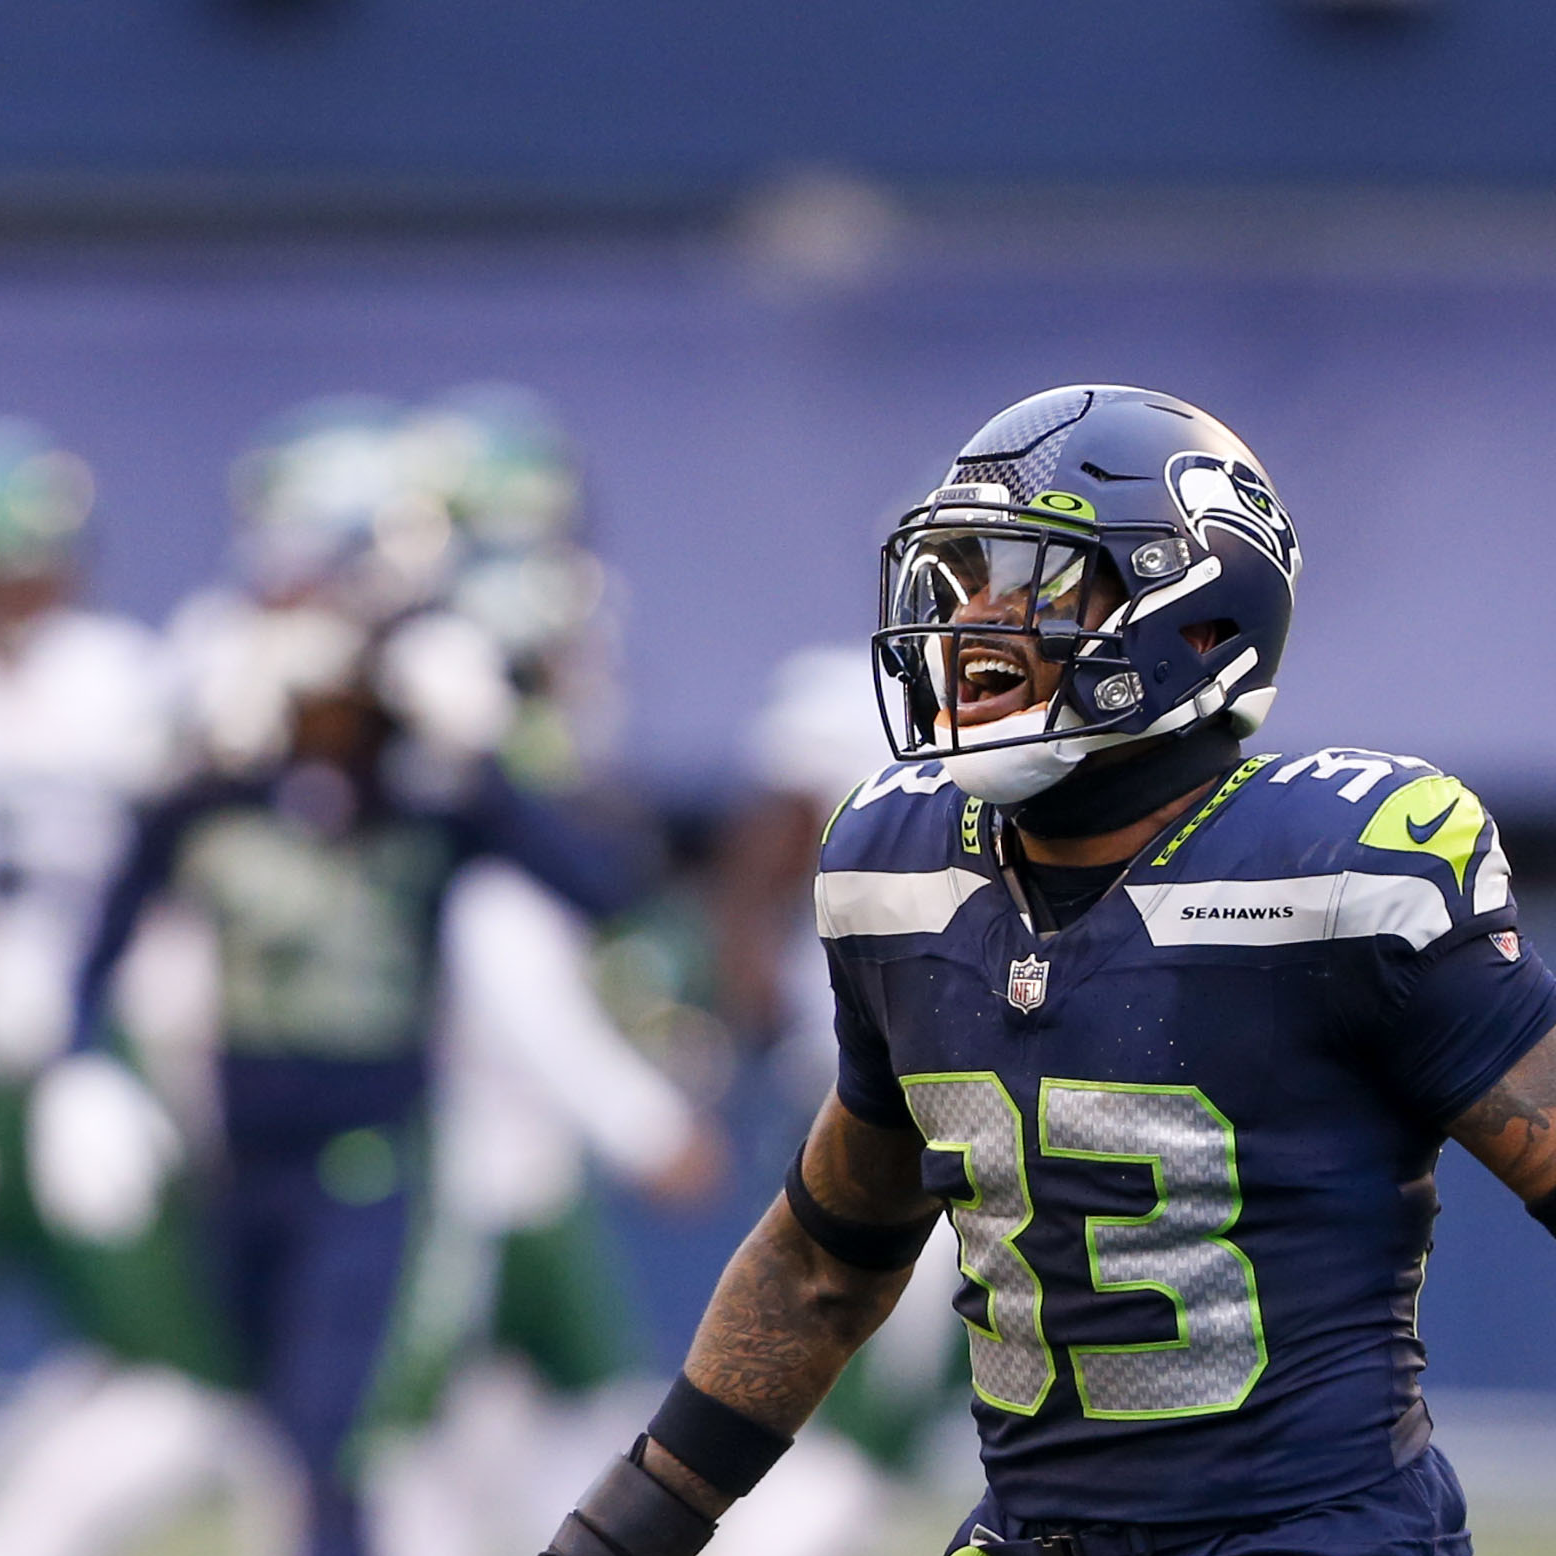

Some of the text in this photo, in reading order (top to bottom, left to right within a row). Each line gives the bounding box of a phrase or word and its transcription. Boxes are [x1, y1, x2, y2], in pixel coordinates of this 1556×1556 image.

[1180, 906, 1294, 920] SEAHAWKS
[1013, 981, 1039, 1002] NFL
[899, 1070, 1269, 1420] 33
